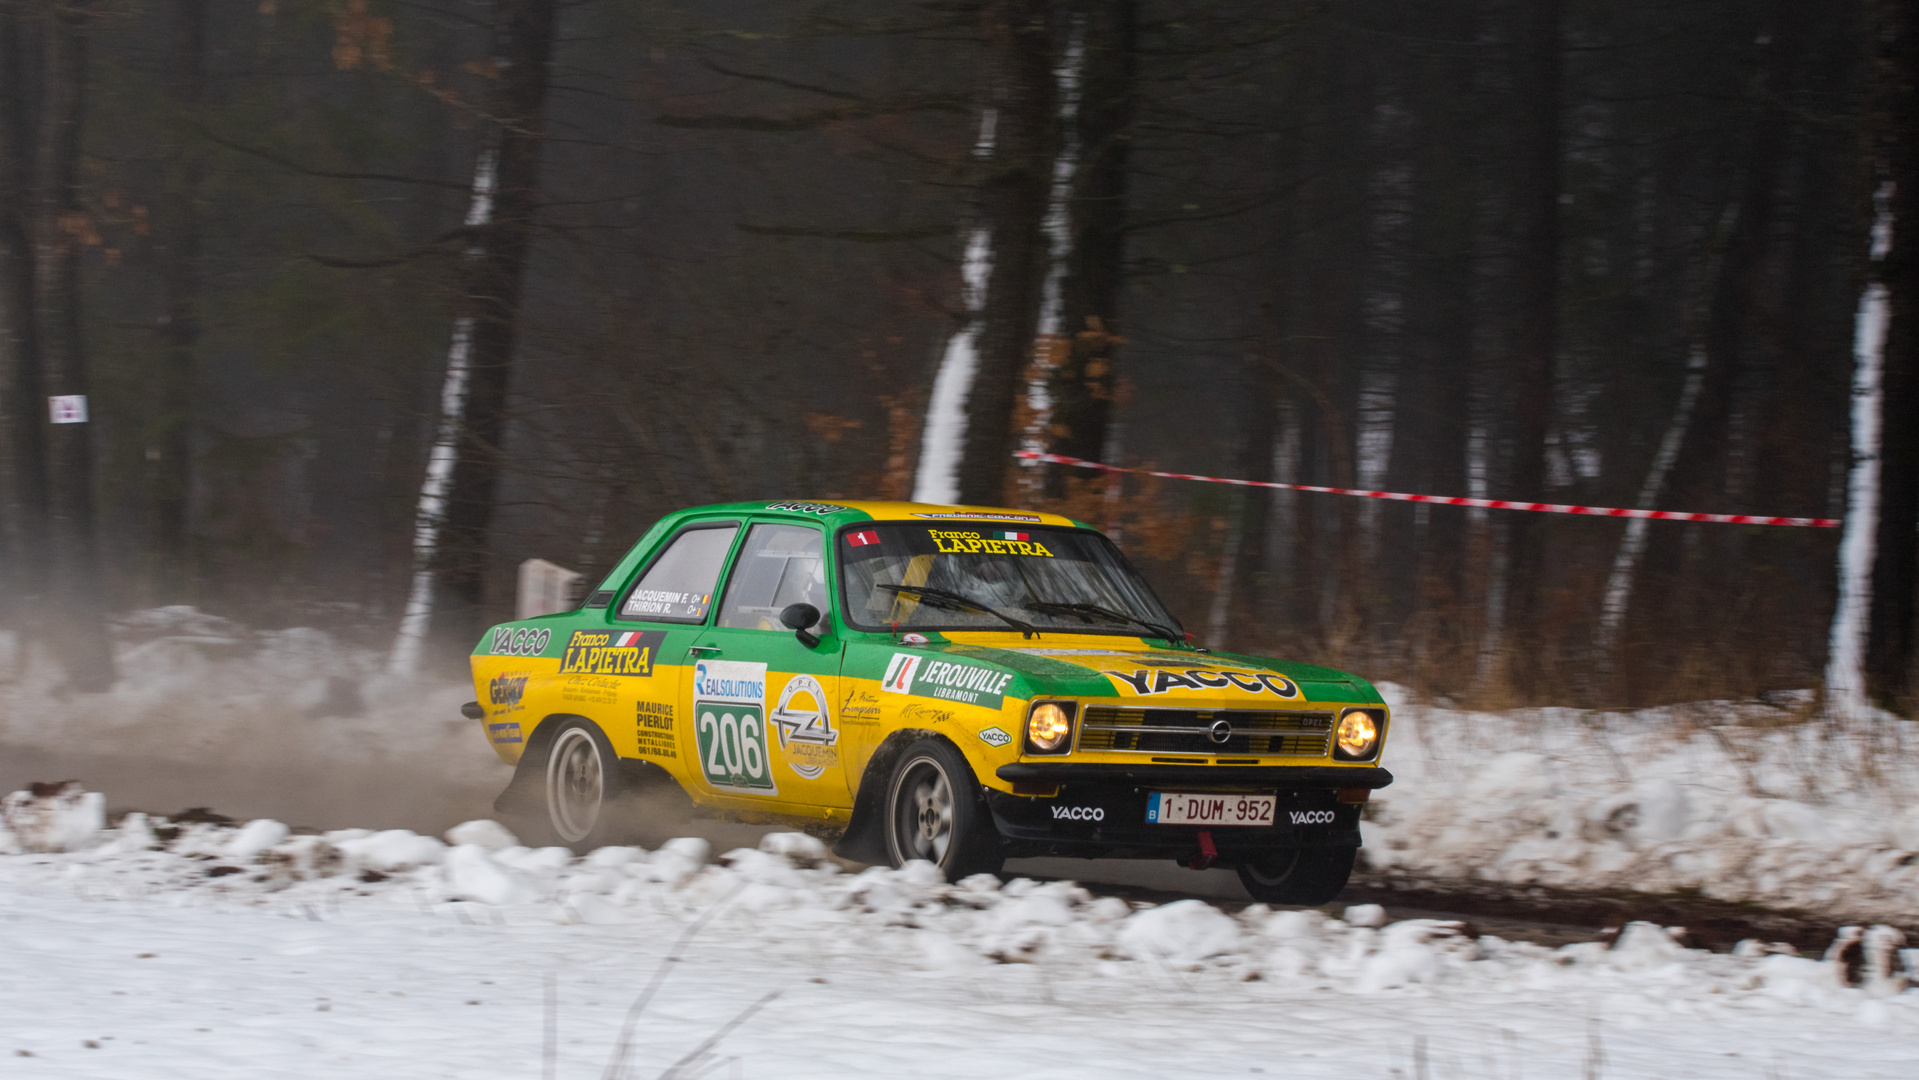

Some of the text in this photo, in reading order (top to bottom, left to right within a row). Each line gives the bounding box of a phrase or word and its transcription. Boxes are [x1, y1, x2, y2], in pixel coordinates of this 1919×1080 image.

[857, 532, 868, 545] 1
[928, 529, 980, 539] Franco
[933, 538, 1054, 557] LAPIETRA
[631, 589, 681, 604] JACQUEMIN
[628, 600, 663, 613] THIRION
[490, 627, 552, 656] YACCO
[569, 631, 610, 647] Franco
[562, 647, 649, 674] LAPIETRA
[919, 660, 1013, 695] JEROUVILLE
[1102, 669, 1299, 699] YACCO
[933, 686, 979, 704] LIBRAMONT
[637, 701, 674, 717] MAURICE
[637, 713, 674, 731] PIERLOT
[637, 730, 675, 741] CONSTRUCTIONS
[982, 732, 1010, 743] YACCO
[700, 711, 763, 779] 206
[793, 744, 837, 758] JACQUEMIN
[1051, 805, 1105, 822] YACCO
[1149, 810, 1157, 820] B
[1289, 811, 1335, 825] YACCO
